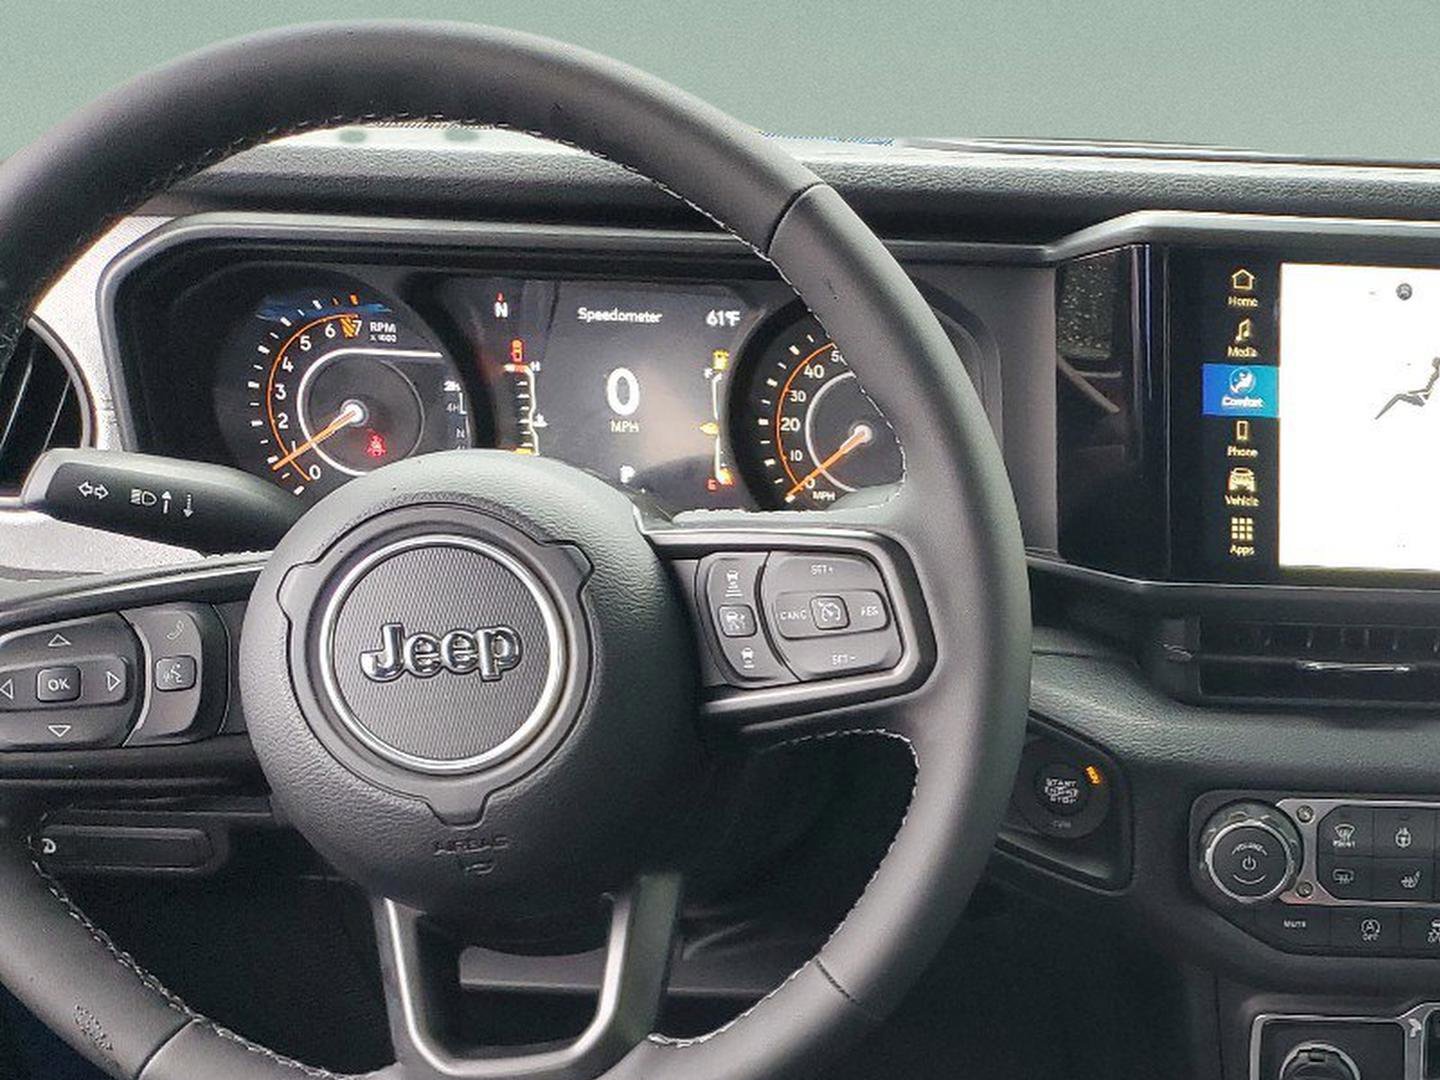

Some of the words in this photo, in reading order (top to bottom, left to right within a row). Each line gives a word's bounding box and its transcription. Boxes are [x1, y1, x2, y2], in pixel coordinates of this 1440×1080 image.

[1228, 296, 1258, 307] Home
[494, 302, 508, 317] N
[578, 307, 662, 323] Speedometer
[325, 324, 336, 338] 6
[353, 321, 362, 334] 7
[370, 322, 396, 333] RPM
[300, 335, 312, 350] 5
[1228, 347, 1258, 358] Media
[282, 357, 294, 373] 4
[804, 365, 824, 379] 40
[275, 383, 286, 399] 3
[607, 368, 639, 415] 0
[790, 391, 806, 402] 30
[278, 414, 289, 429] 2
[610, 420, 639, 433] MPH
[781, 418, 800, 431] 20
[790, 450, 803, 461] 10
[1228, 446, 1258, 458] Phone
[309, 465, 321, 479] 0
[813, 491, 835, 500] MPH
[1225, 495, 1259, 507] Vehicle
[1230, 545, 1255, 557] Apps
[359, 622, 523, 683] Jeep
[48, 678, 71, 691] OK
